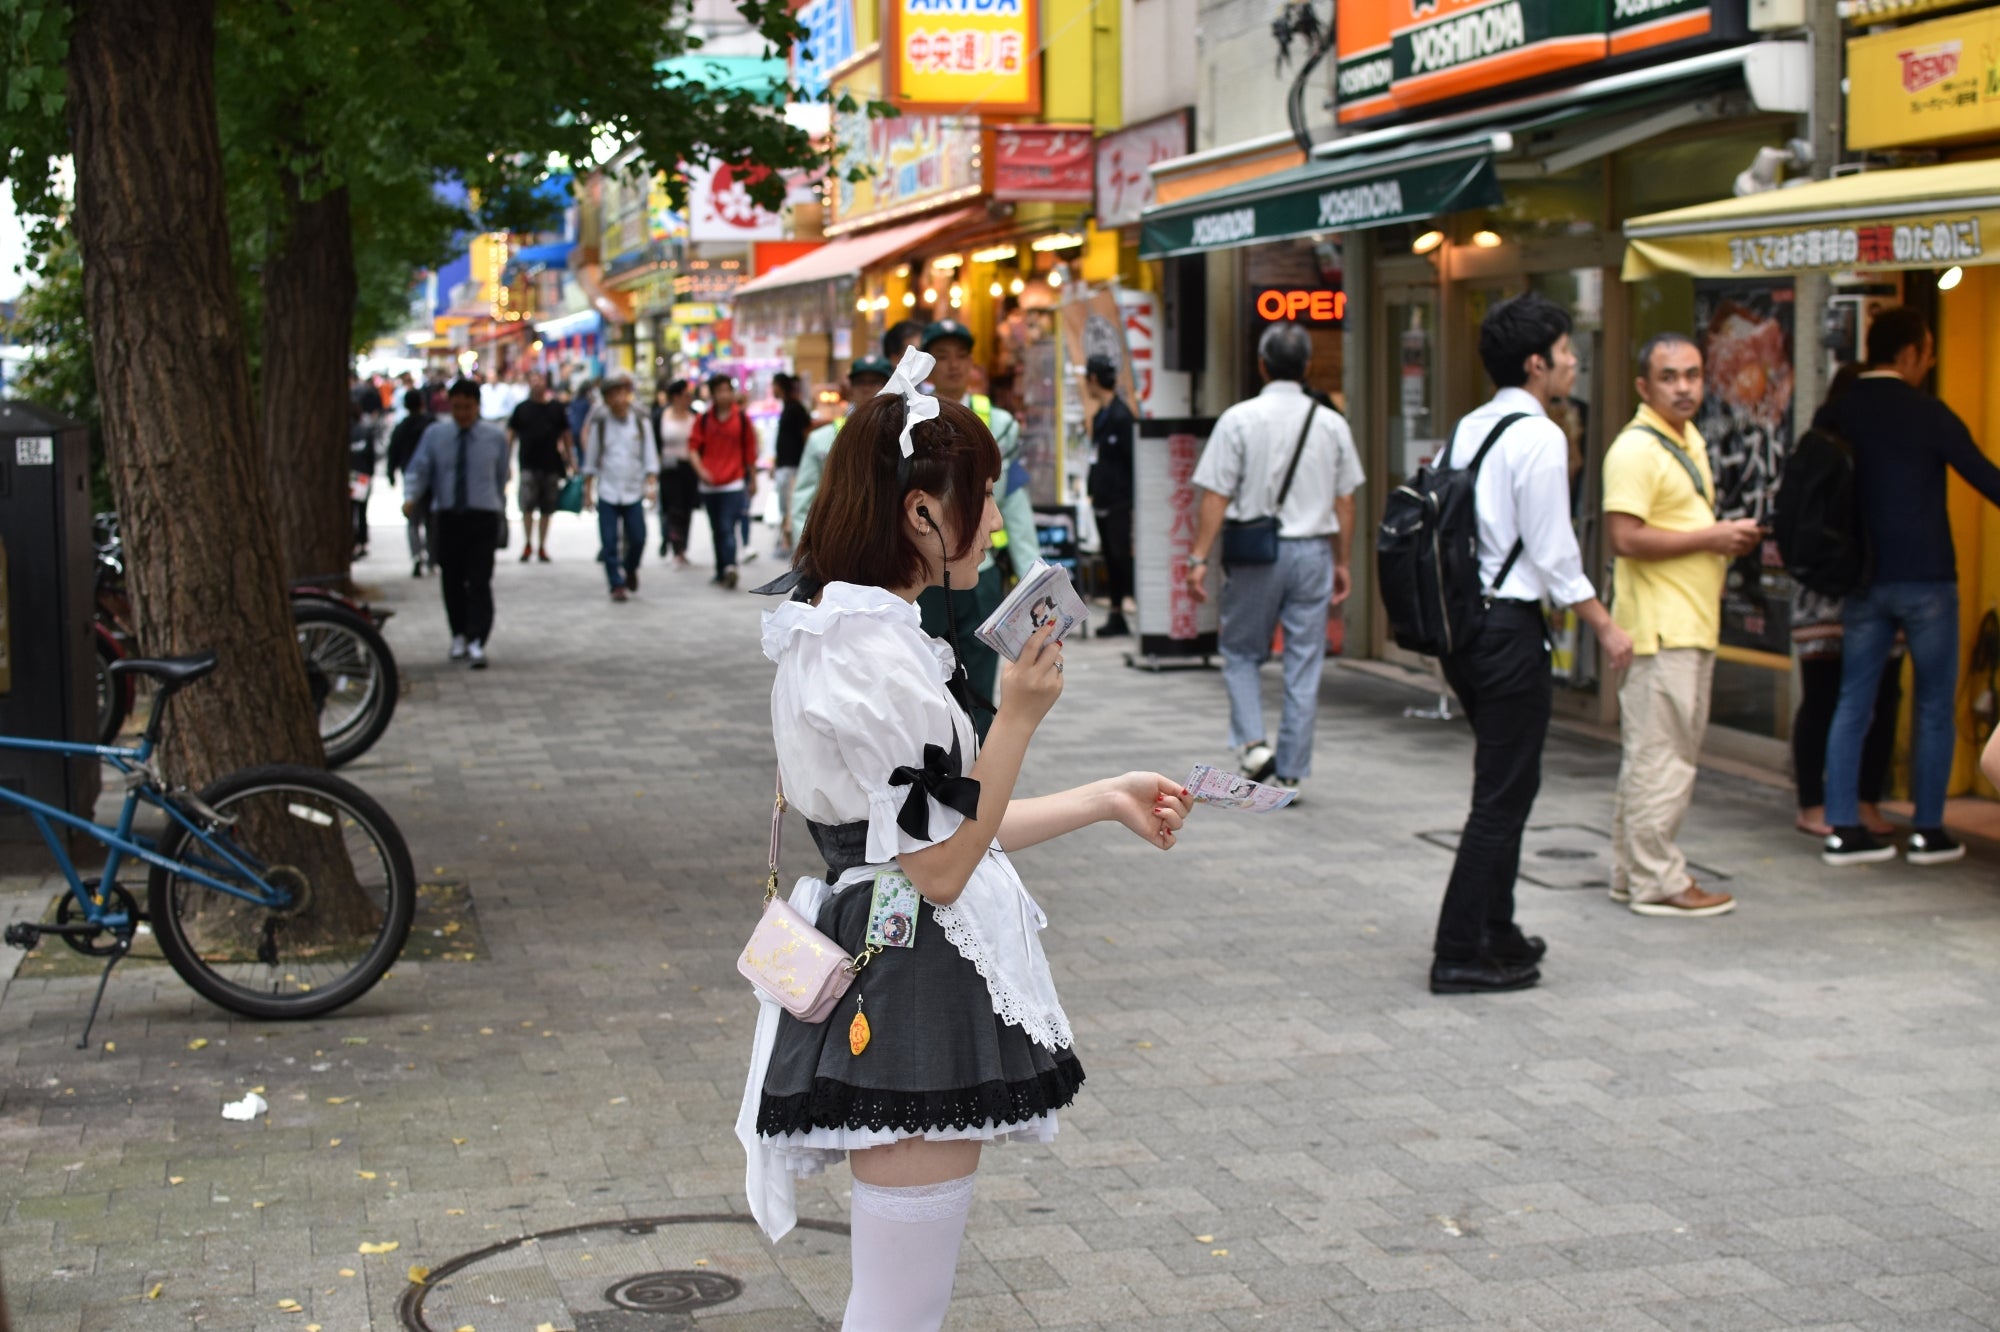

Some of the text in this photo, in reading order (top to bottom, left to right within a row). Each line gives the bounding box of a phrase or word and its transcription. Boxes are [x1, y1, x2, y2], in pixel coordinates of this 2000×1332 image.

[1411, 1, 1525, 74] YOSHINOYA
[1318, 180, 1403, 226] YOSHINOYA
[1191, 207, 1256, 246] YOSHINOYA
